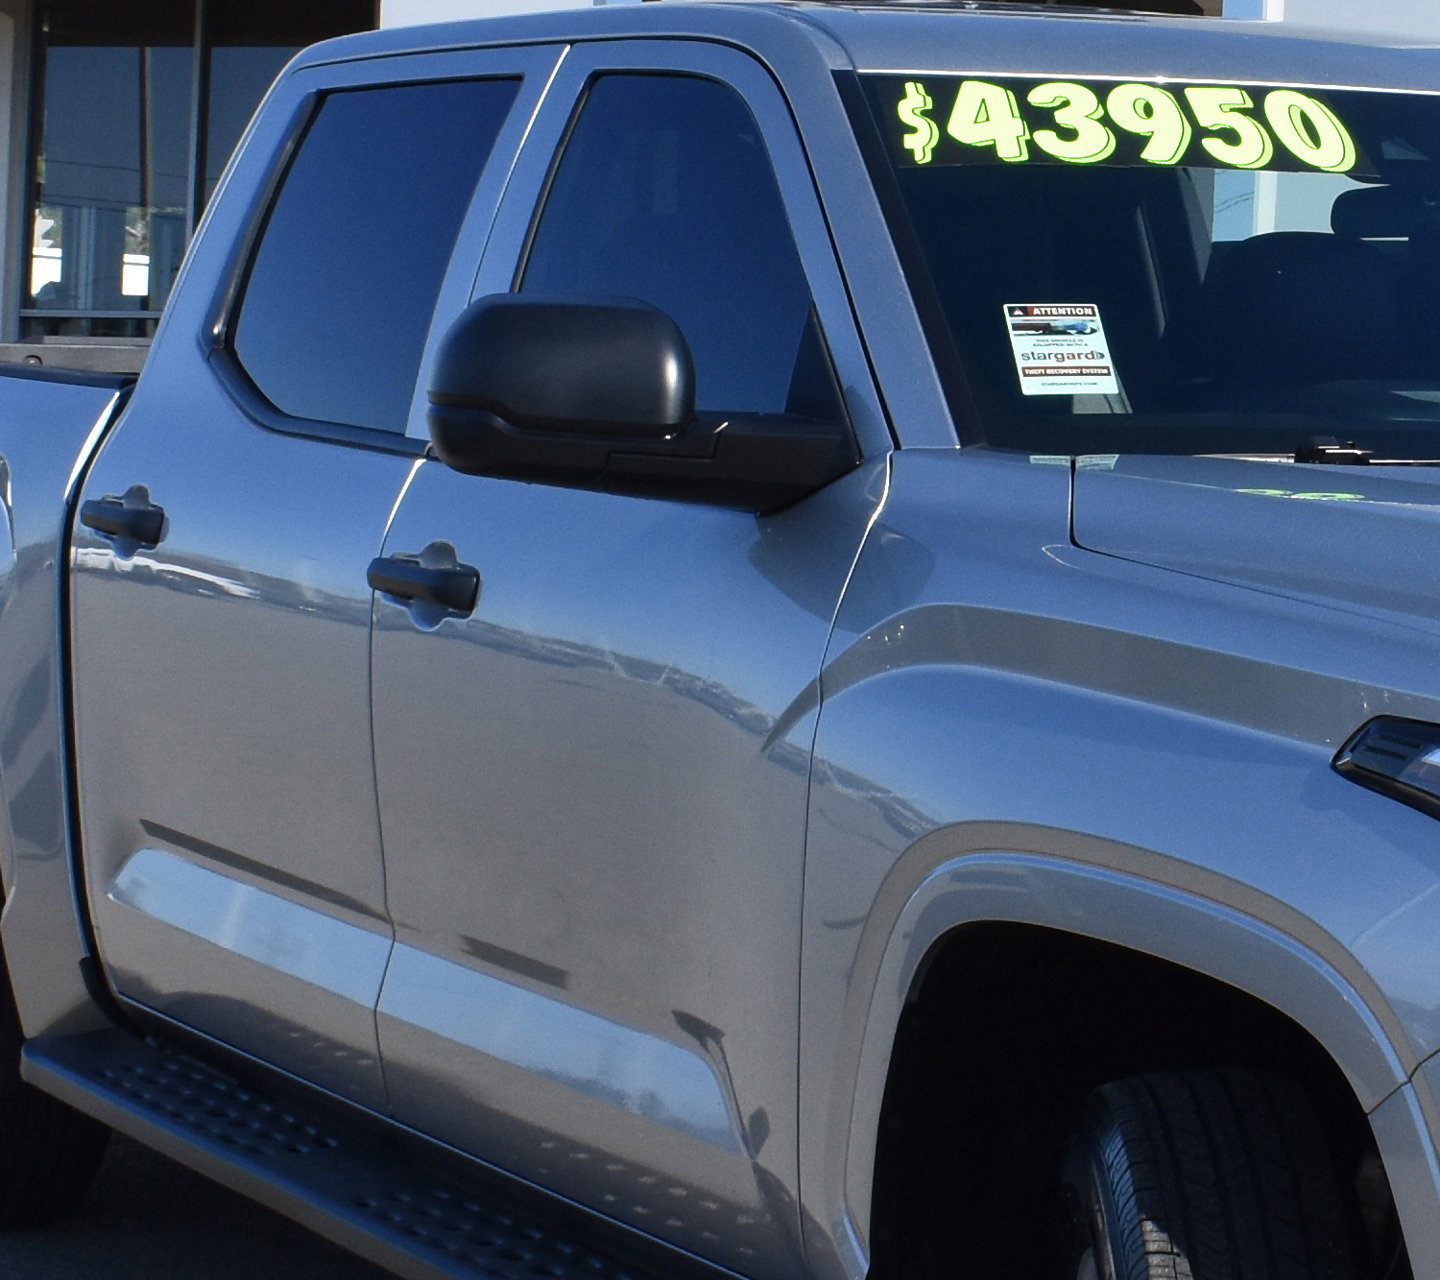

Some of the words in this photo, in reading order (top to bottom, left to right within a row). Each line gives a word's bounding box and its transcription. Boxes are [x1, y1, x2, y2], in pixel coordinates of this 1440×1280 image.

[897, 80, 1356, 172] $43950
[1033, 307, 1093, 316] ATTENTION
[1021, 350, 1096, 363] stargard
